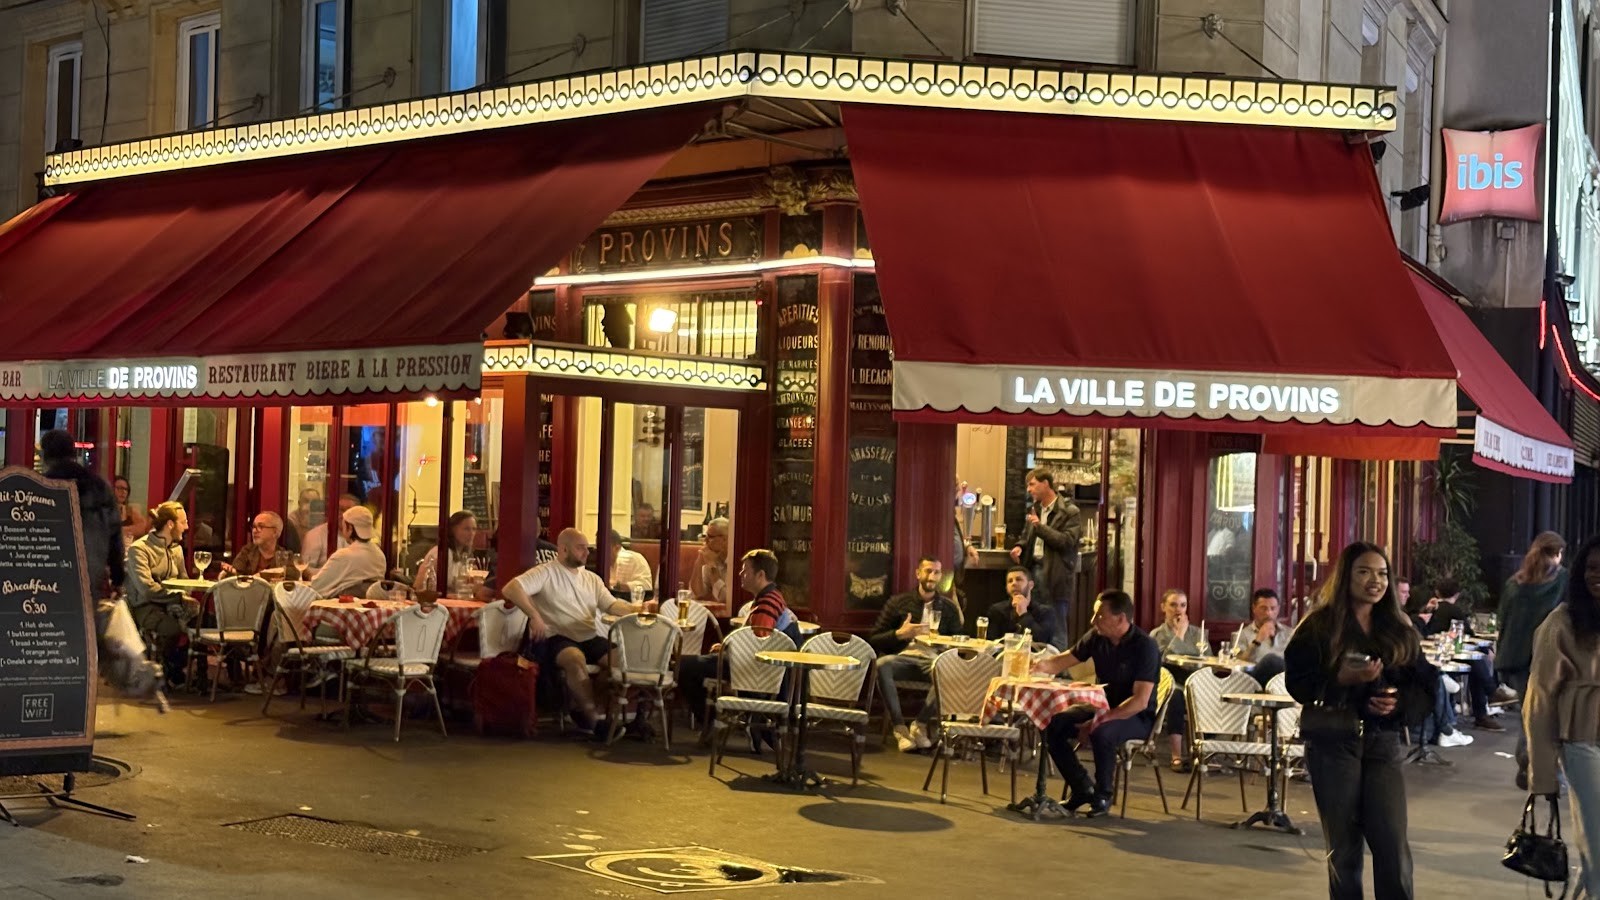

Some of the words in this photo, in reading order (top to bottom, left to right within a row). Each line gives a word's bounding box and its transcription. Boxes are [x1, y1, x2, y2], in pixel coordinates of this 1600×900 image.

[1458, 153, 1523, 190] ibis
[600, 222, 733, 265] PROVINS
[2, 370, 21, 387] BAR
[109, 367, 130, 389] DE
[133, 365, 197, 389] PROVINS
[208, 362, 297, 384] RESTAURANT
[306, 359, 350, 380] BIERE
[357, 358, 366, 378] A
[373, 358, 388, 378] LA
[396, 354, 472, 377] PRESSION
[1015, 376, 1055, 403] LA
[1059, 378, 1144, 406] VILLE
[1155, 380, 1195, 407] DE
[1209, 383, 1339, 413] PROVINS
[850, 446, 893, 464] BRASSERIE
[2, 578, 60, 595] Breakfast
[25, 708, 48, 719] WIFI
[26, 698, 49, 708] FREE
